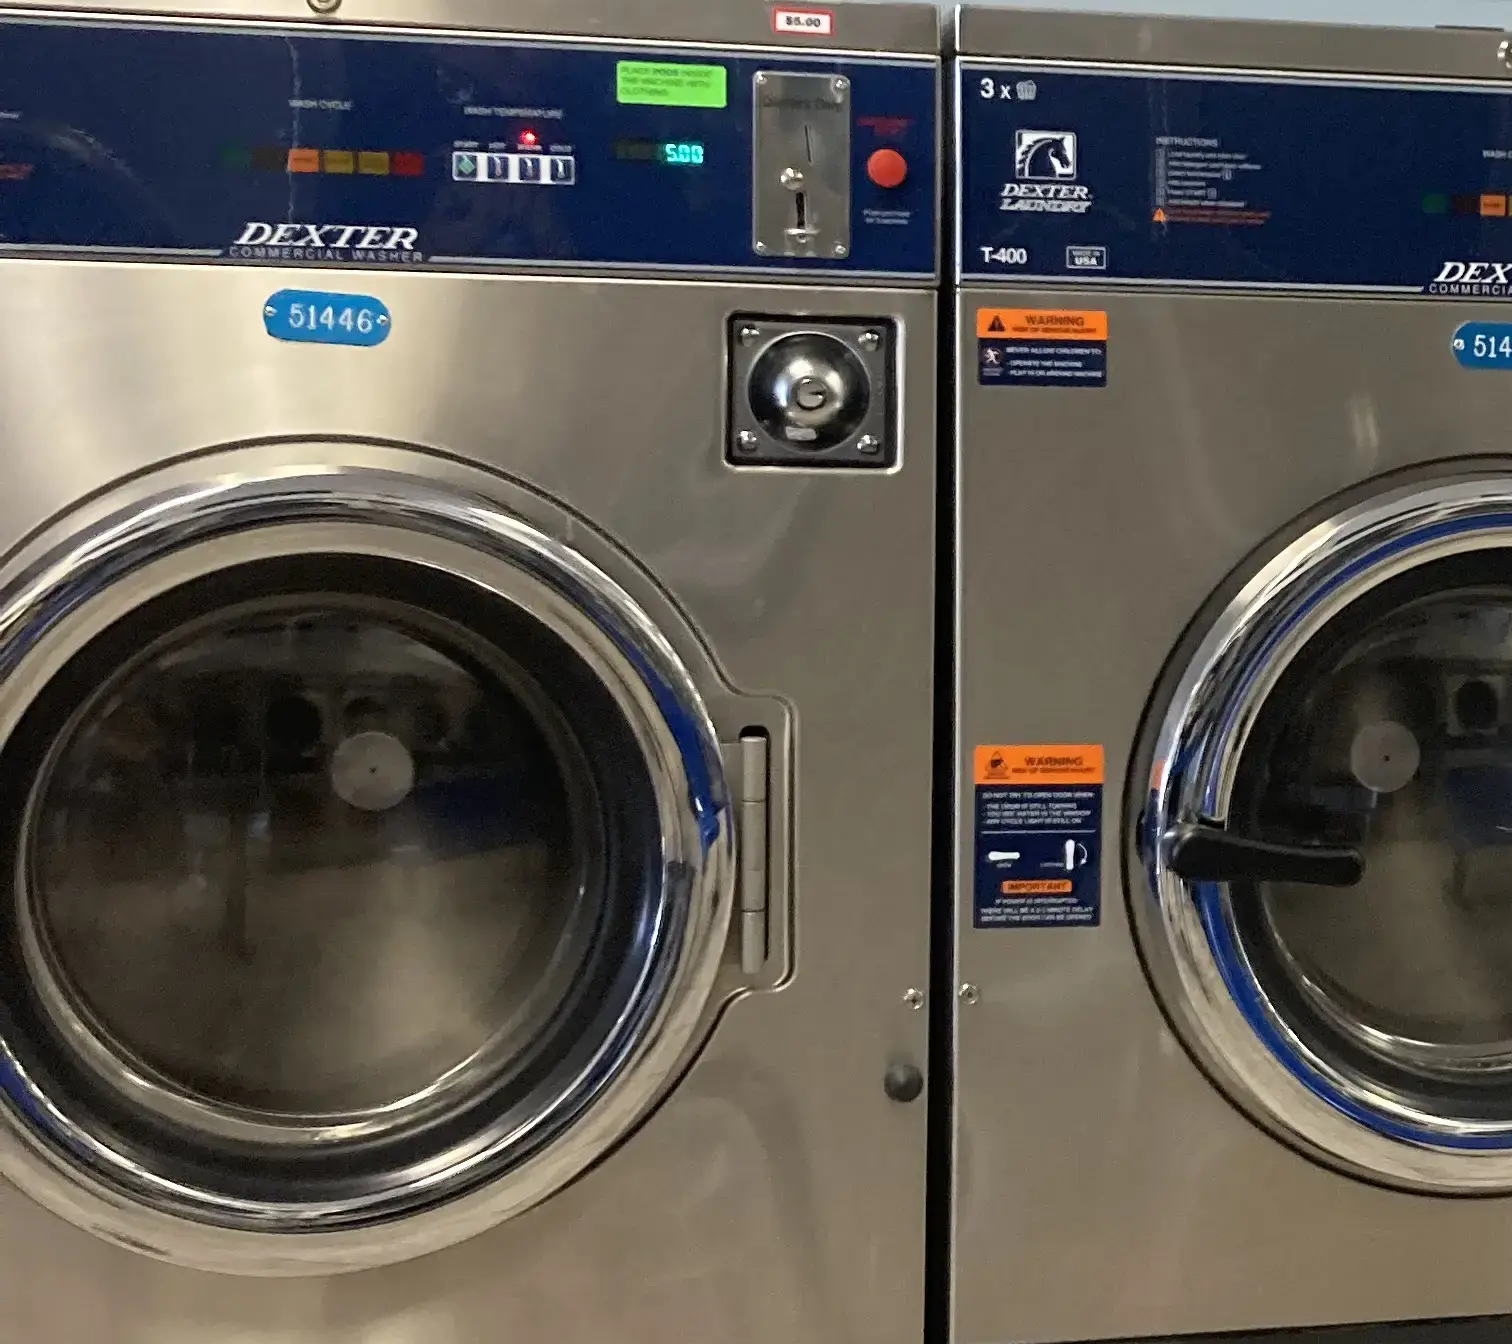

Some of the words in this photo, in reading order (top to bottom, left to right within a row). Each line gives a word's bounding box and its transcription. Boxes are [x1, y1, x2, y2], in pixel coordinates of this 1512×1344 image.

[785, 14, 821, 28] $5.00
[980, 77, 995, 99] 3
[1000, 182, 1089, 199] DEXTER
[1000, 198, 1093, 213] LAUNDRY
[234, 222, 419, 250] DEXTER
[229, 245, 344, 261] COMMERCIAL
[352, 249, 423, 263] WASHER
[980, 247, 1028, 264] T-400
[289, 303, 373, 333] 51446
[1025, 315, 1085, 326] WARNING
[1025, 757, 1083, 767] WARNING
[1008, 883, 1067, 891] IMPORTANT
